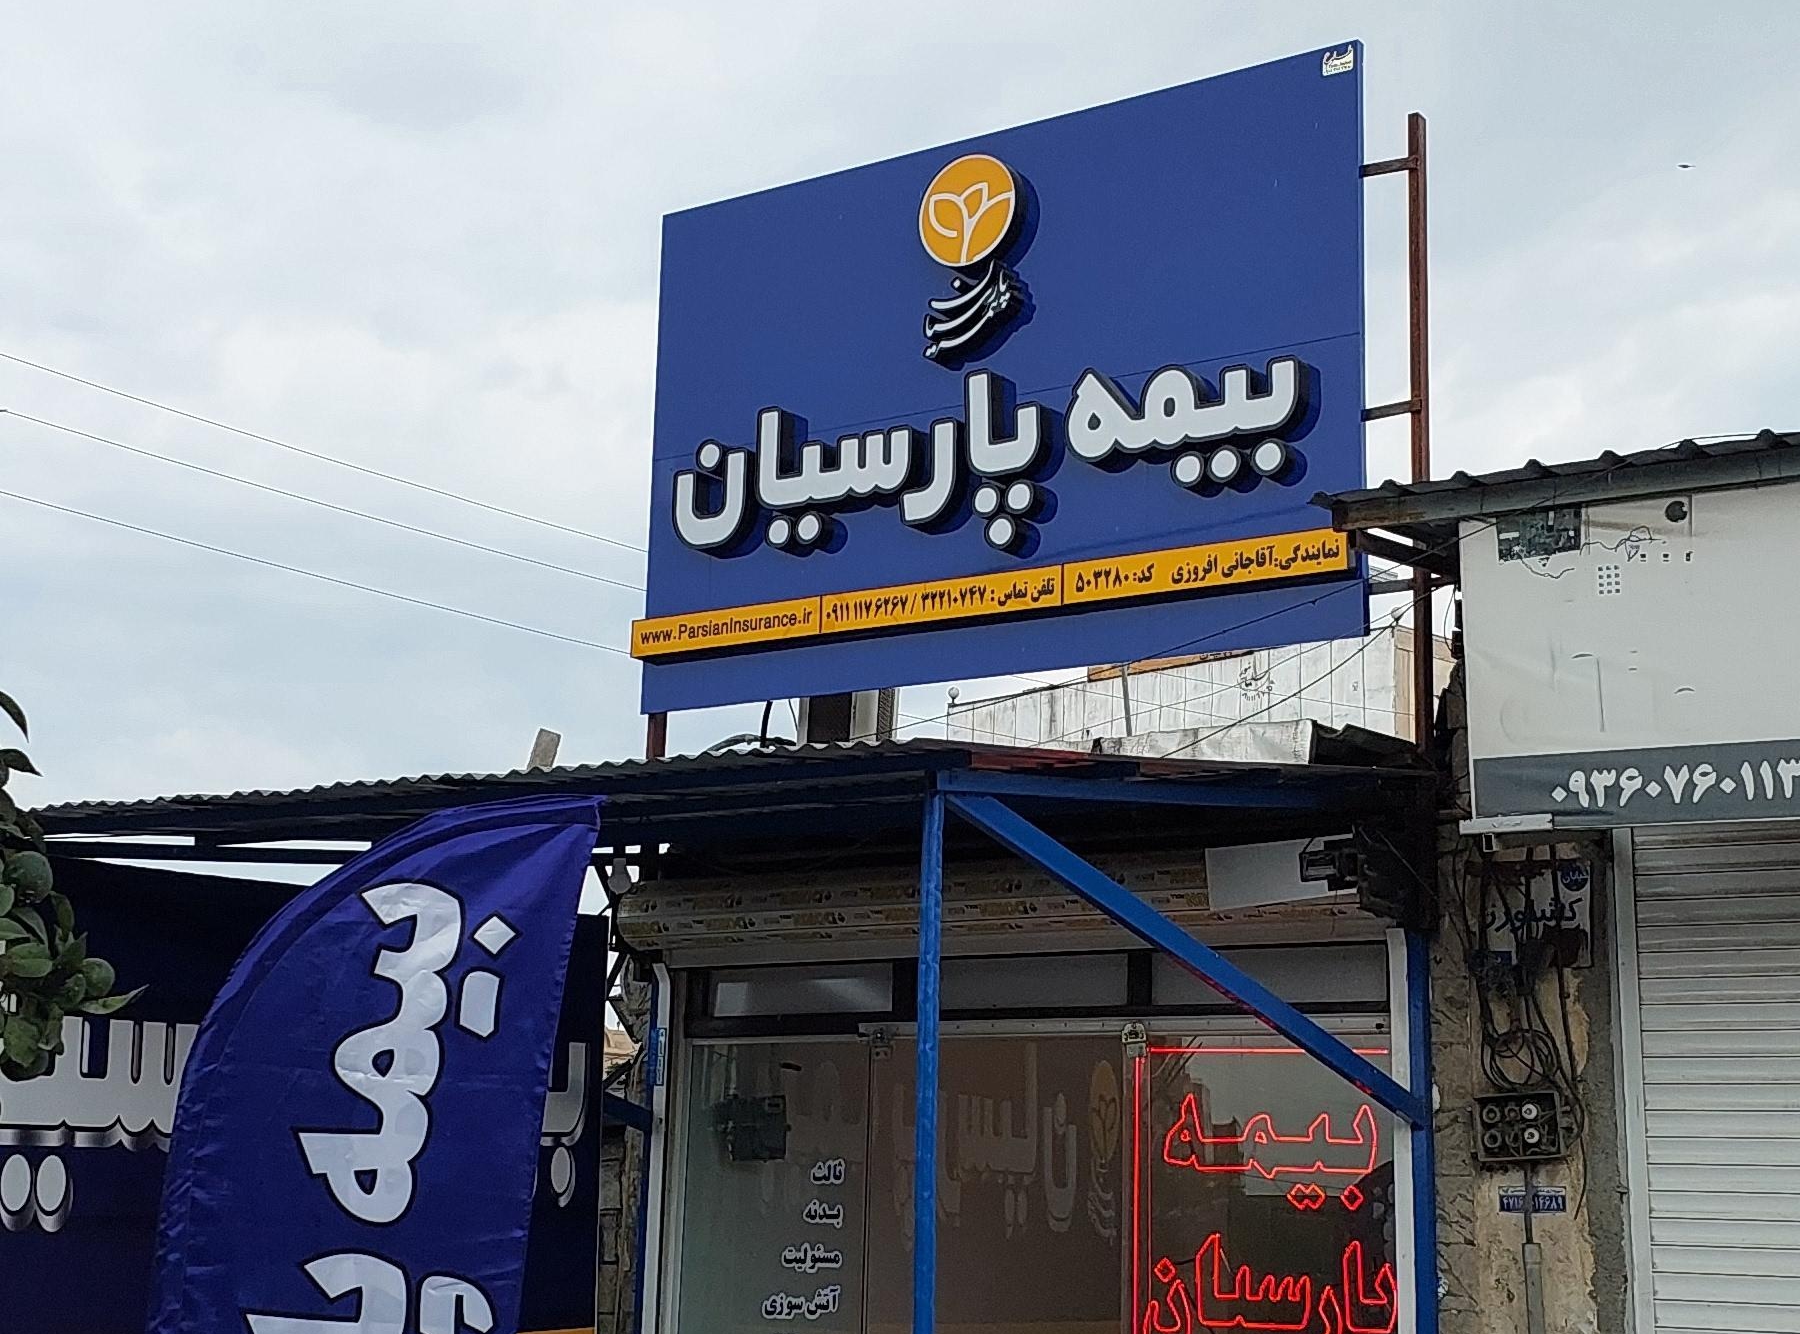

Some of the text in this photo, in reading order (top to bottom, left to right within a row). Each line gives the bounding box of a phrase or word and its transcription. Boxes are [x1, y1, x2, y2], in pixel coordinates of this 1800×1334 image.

[674, 358, 1298, 550] بیمه پارسیان
[1171, 553, 1219, 584] افروزی
[1030, 577, 1056, 603] تلفن
[640, 606, 814, 645] www.ParsianInsurance.ir
[1551, 757, 1800, 808] ۰۹۳۶۰۷۶۰۱۱۳
[297, 881, 518, 1224] بیمه
[1163, 1093, 1378, 1210] بیمه
[811, 1158, 845, 1185] ثالث
[803, 1199, 844, 1228] بدنه
[782, 1242, 843, 1273] مسئولیت
